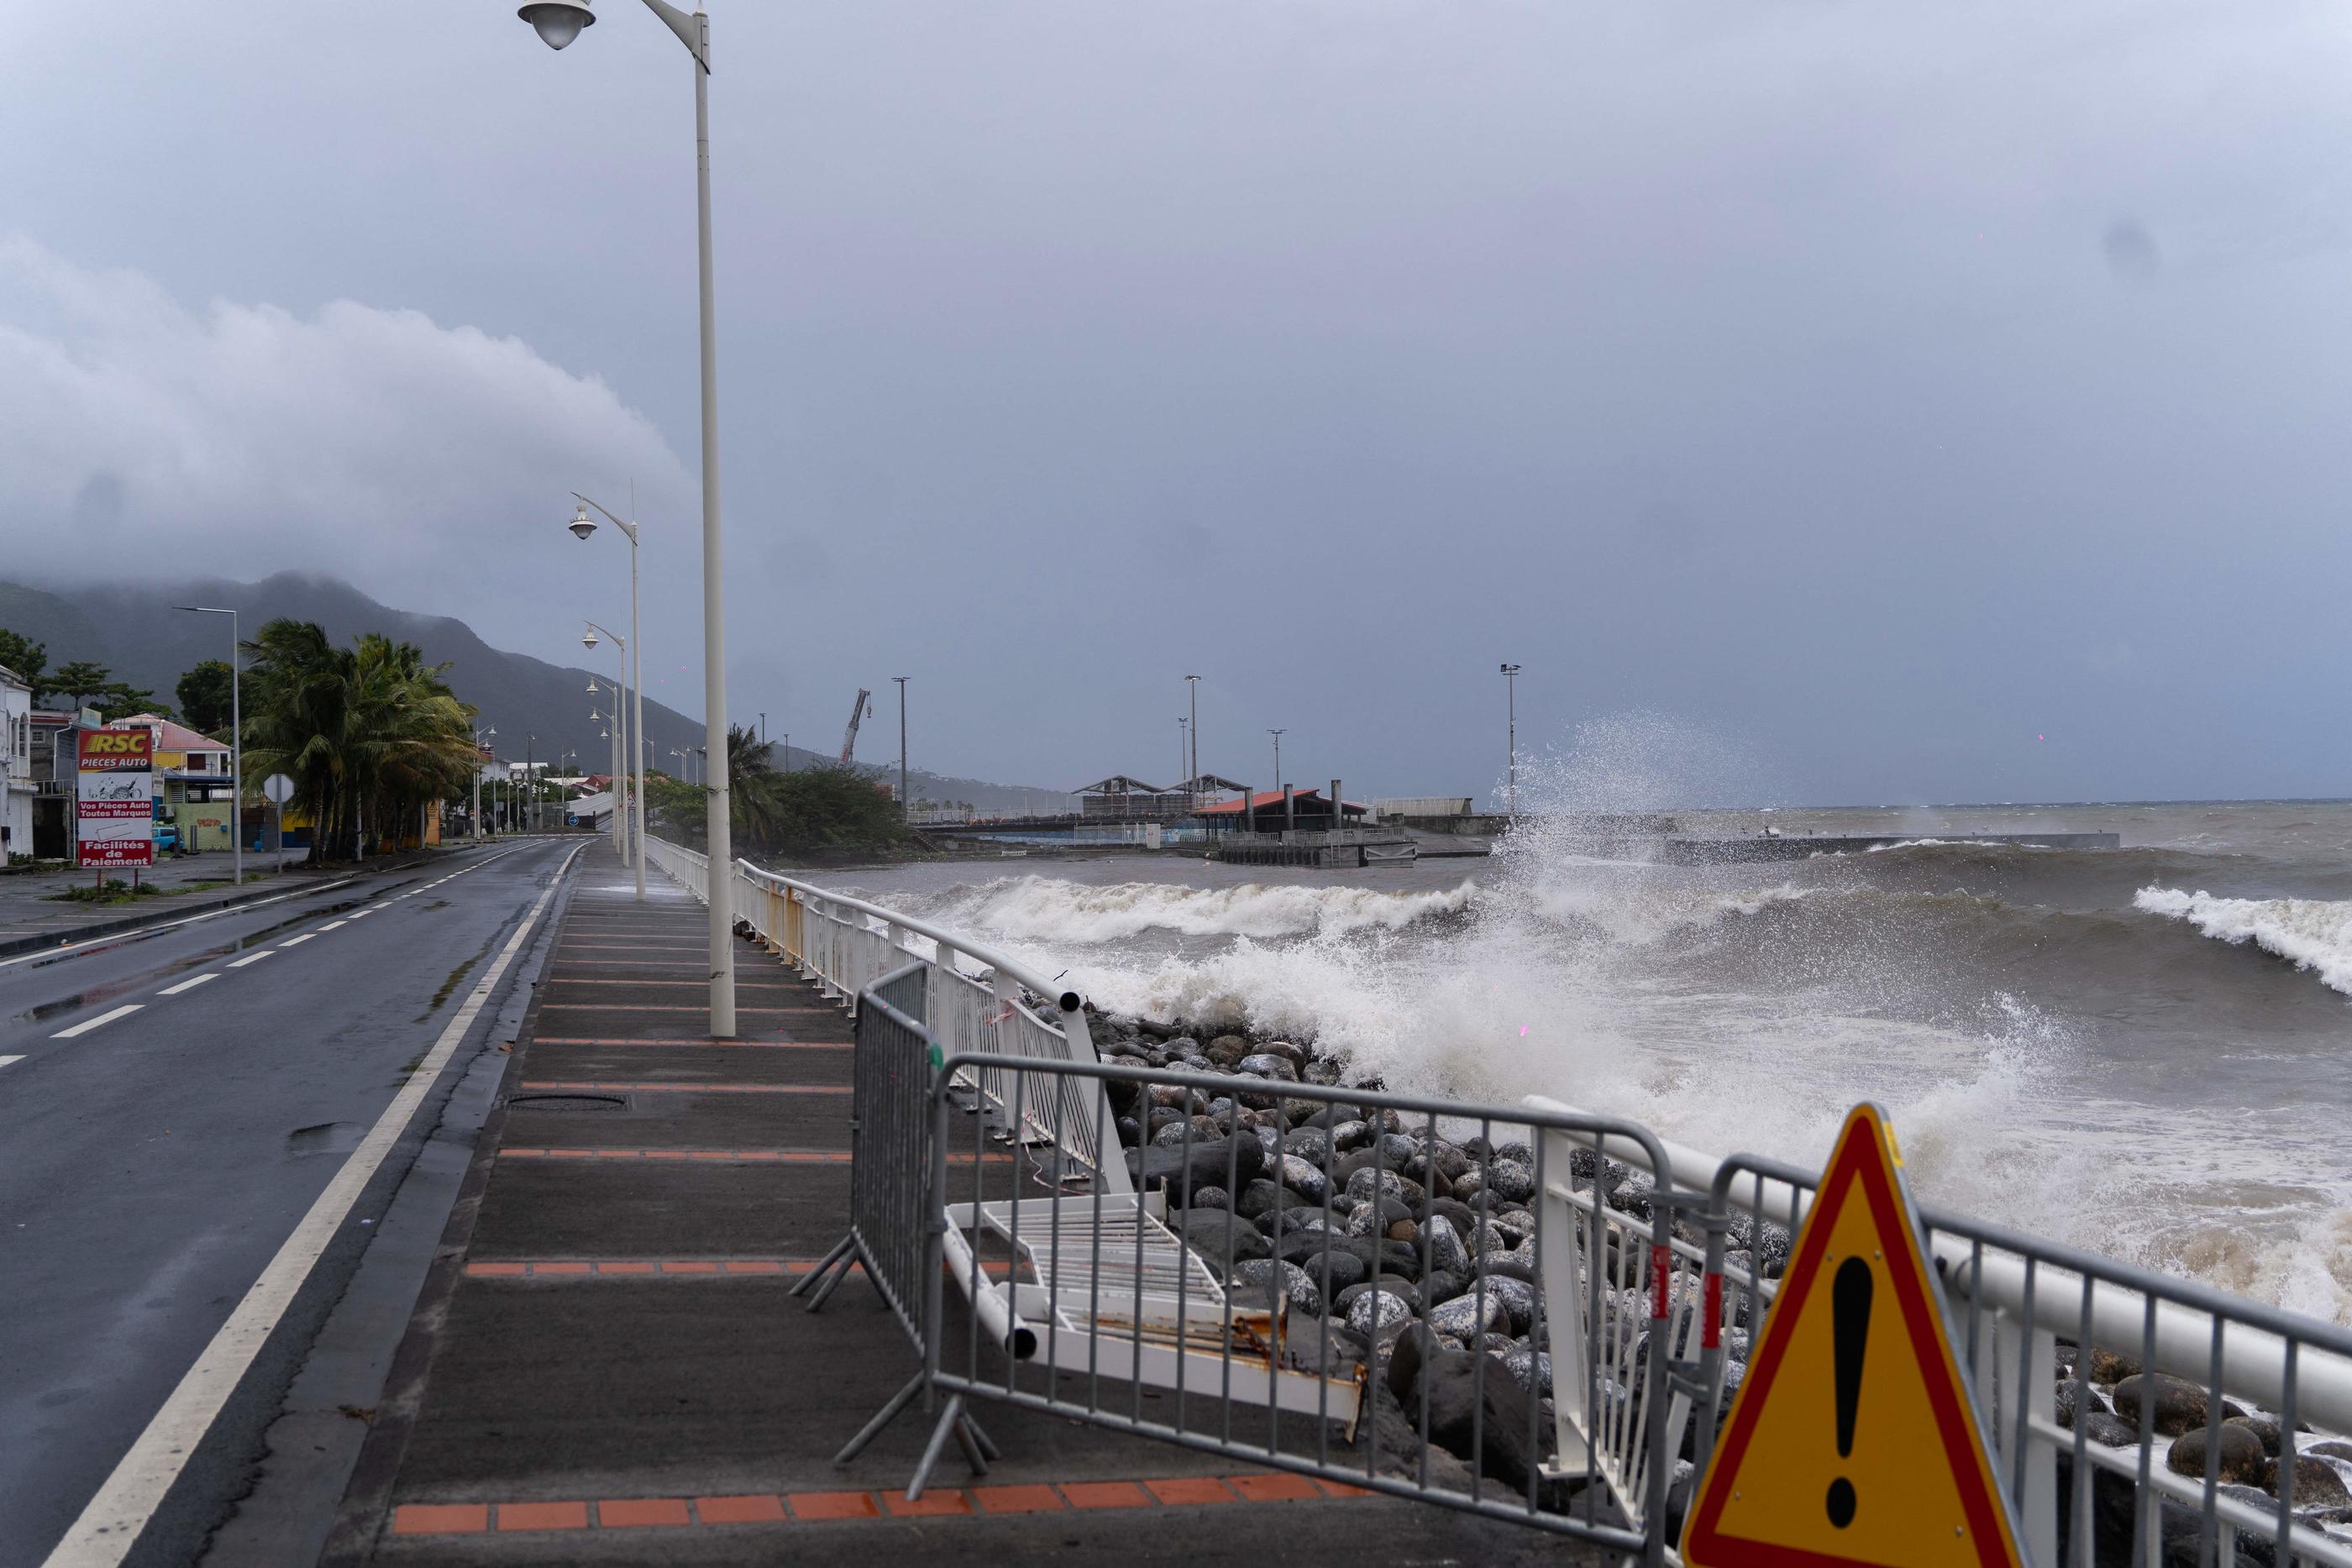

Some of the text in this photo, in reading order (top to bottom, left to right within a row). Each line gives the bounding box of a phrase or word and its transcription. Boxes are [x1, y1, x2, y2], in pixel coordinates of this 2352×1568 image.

[88, 734, 148, 753] RSC
[81, 758, 148, 767] PIECES AUTO
[85, 841, 145, 850] Facilités
[105, 850, 123, 858] de
[82, 857, 148, 866] Paiement
